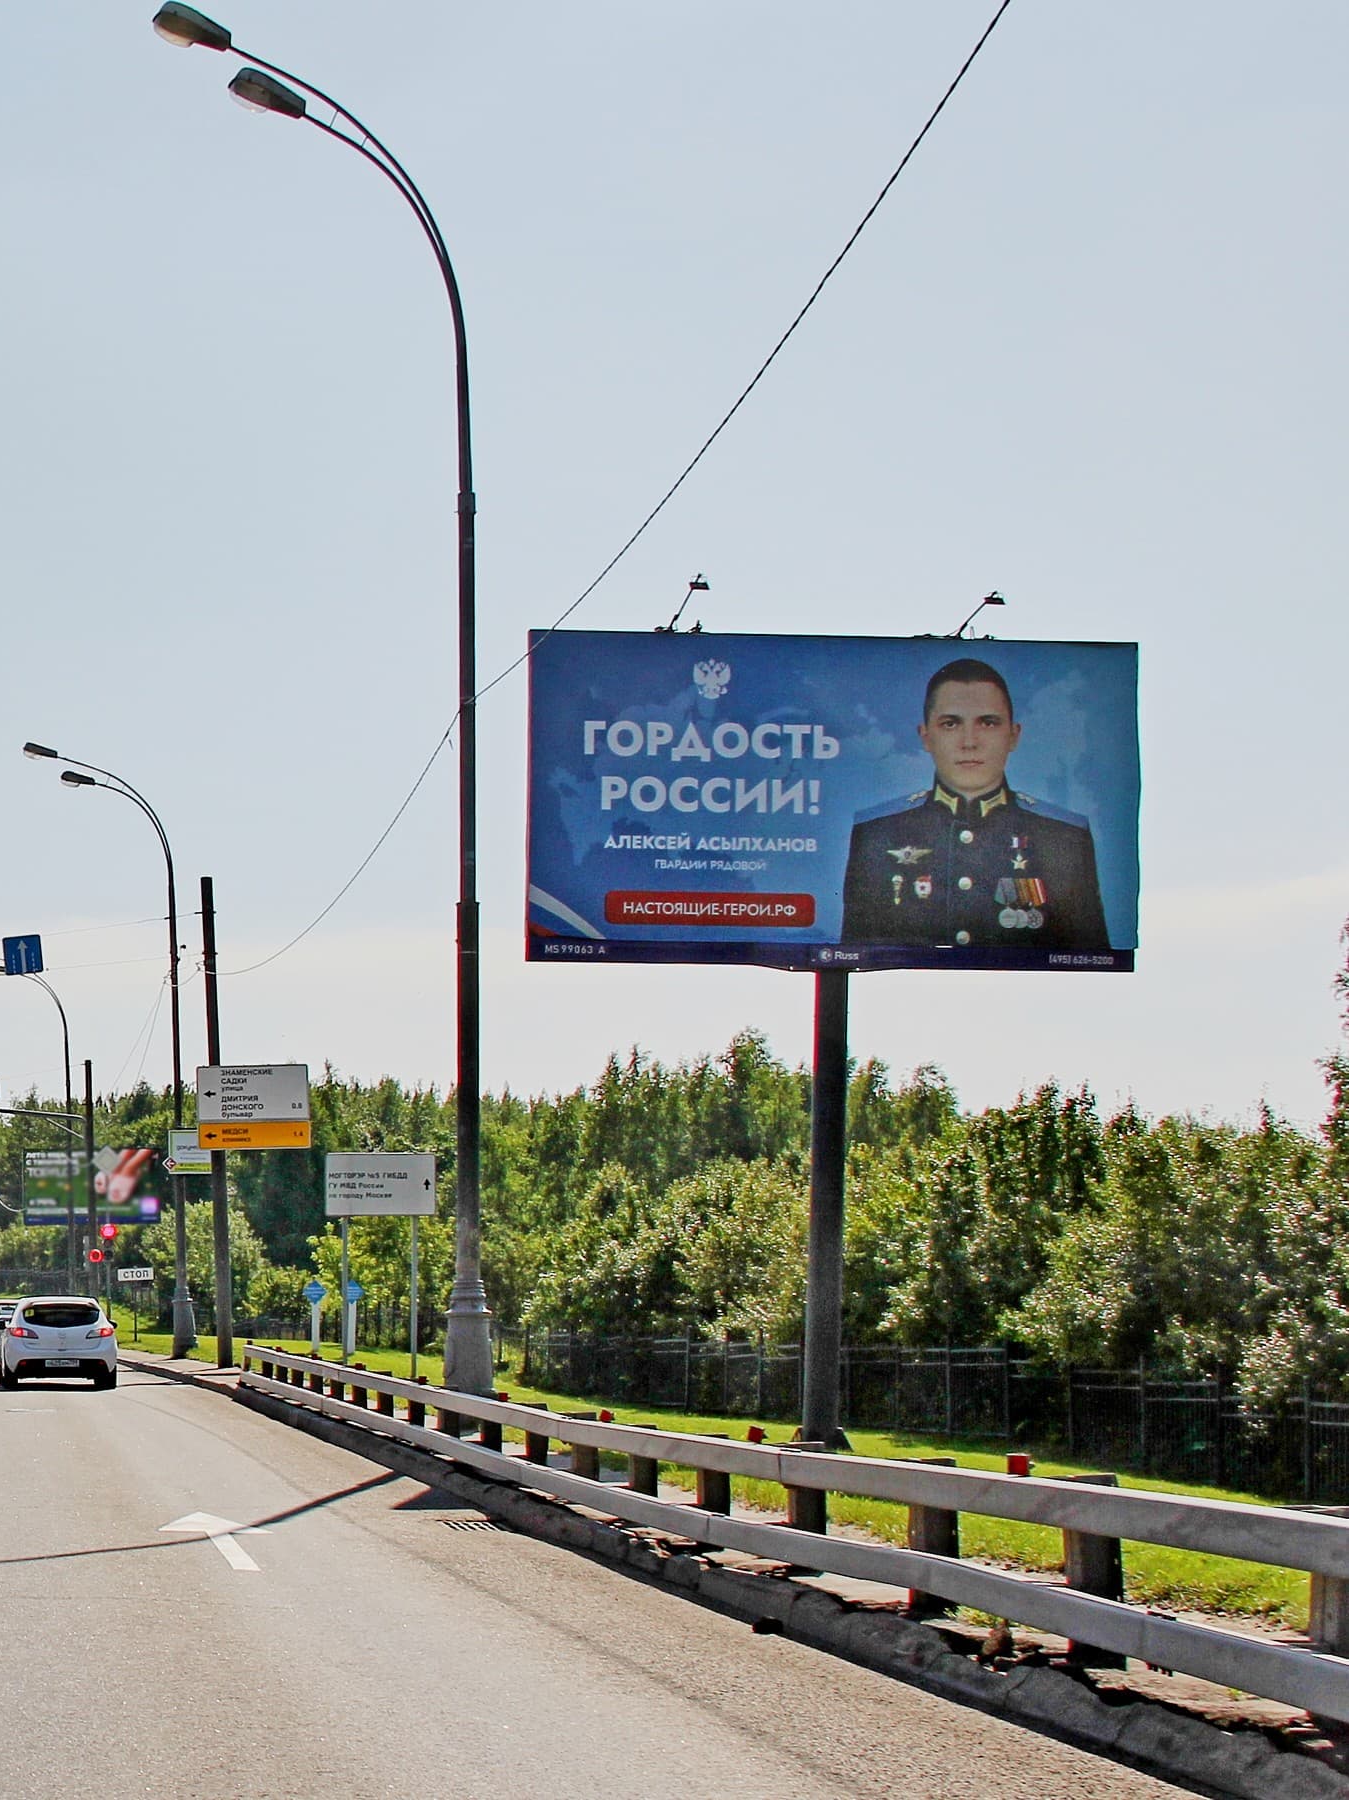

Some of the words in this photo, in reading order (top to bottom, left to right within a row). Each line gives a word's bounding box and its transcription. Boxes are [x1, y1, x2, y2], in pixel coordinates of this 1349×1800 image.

[584, 720, 840, 762] ГОРДОСТЬ
[601, 775, 820, 815] РОССИИ!
[604, 833, 691, 850] АЛЕКСЕЙ
[696, 837, 818, 852] АСЫЛХАНОВ
[654, 859, 707, 870] ГВАРДИИ
[710, 859, 767, 871] РЯДОВОЙ
[623, 901, 797, 917] НАСТОЯЩИЕ-ГЕРОИ.РФ
[834, 951, 859, 960] Russ
[220, 1068, 274, 1076] ЗНАМЕНСКИЕ
[221, 1095, 259, 1103] ДМИТРИЯ
[221, 1103, 264, 1111] ДОНСКОГО
[123, 1270, 149, 1279] СТОП
